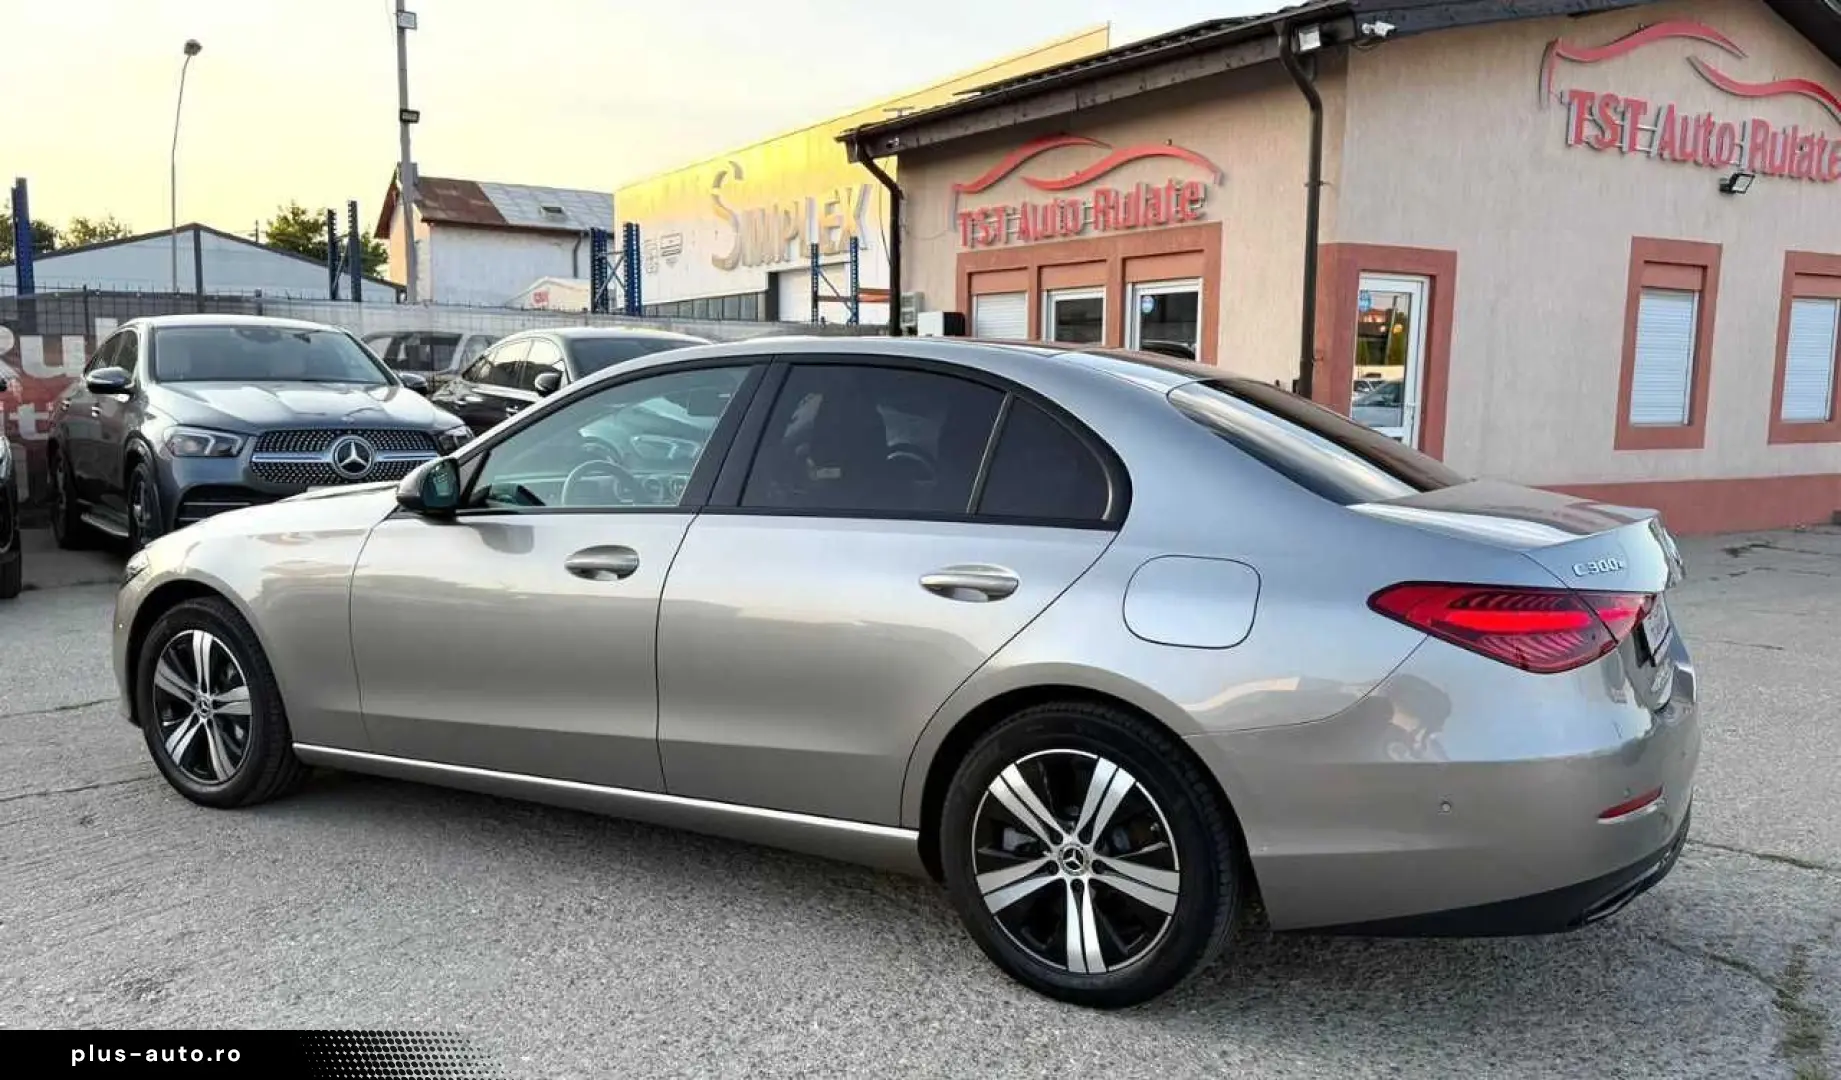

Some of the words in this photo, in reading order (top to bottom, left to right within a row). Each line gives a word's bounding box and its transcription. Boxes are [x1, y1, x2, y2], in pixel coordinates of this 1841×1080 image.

[1566, 89, 1648, 154] TST
[1653, 103, 1737, 167] Auto
[1747, 117, 1841, 182] Rulate
[957, 205, 1009, 248] TST
[1017, 197, 1085, 242] Auto
[1092, 177, 1208, 232] Rulate
